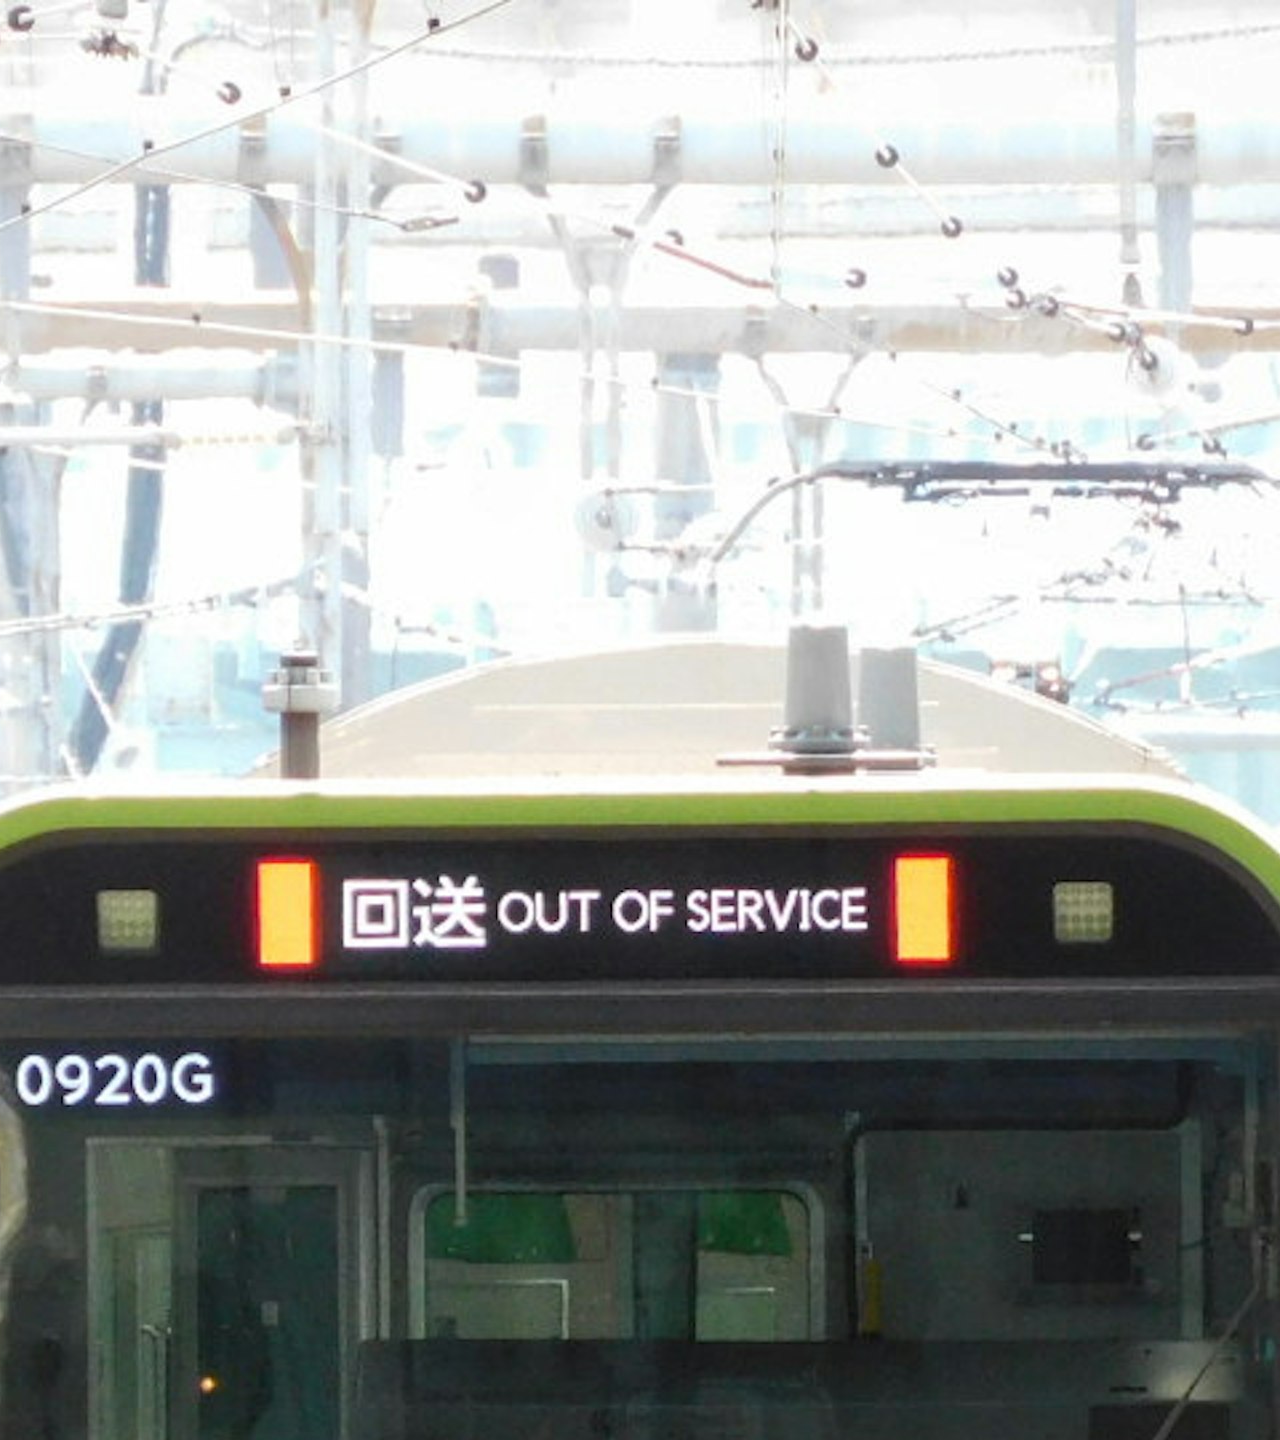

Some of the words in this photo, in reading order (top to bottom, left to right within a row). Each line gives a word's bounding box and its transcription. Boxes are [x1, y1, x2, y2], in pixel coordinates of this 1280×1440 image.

[343, 875, 487, 948] 回送
[497, 889, 601, 933] OUT
[611, 888, 675, 933] OF
[686, 886, 869, 933] SERVICE
[16, 1052, 215, 1105] 0920G
